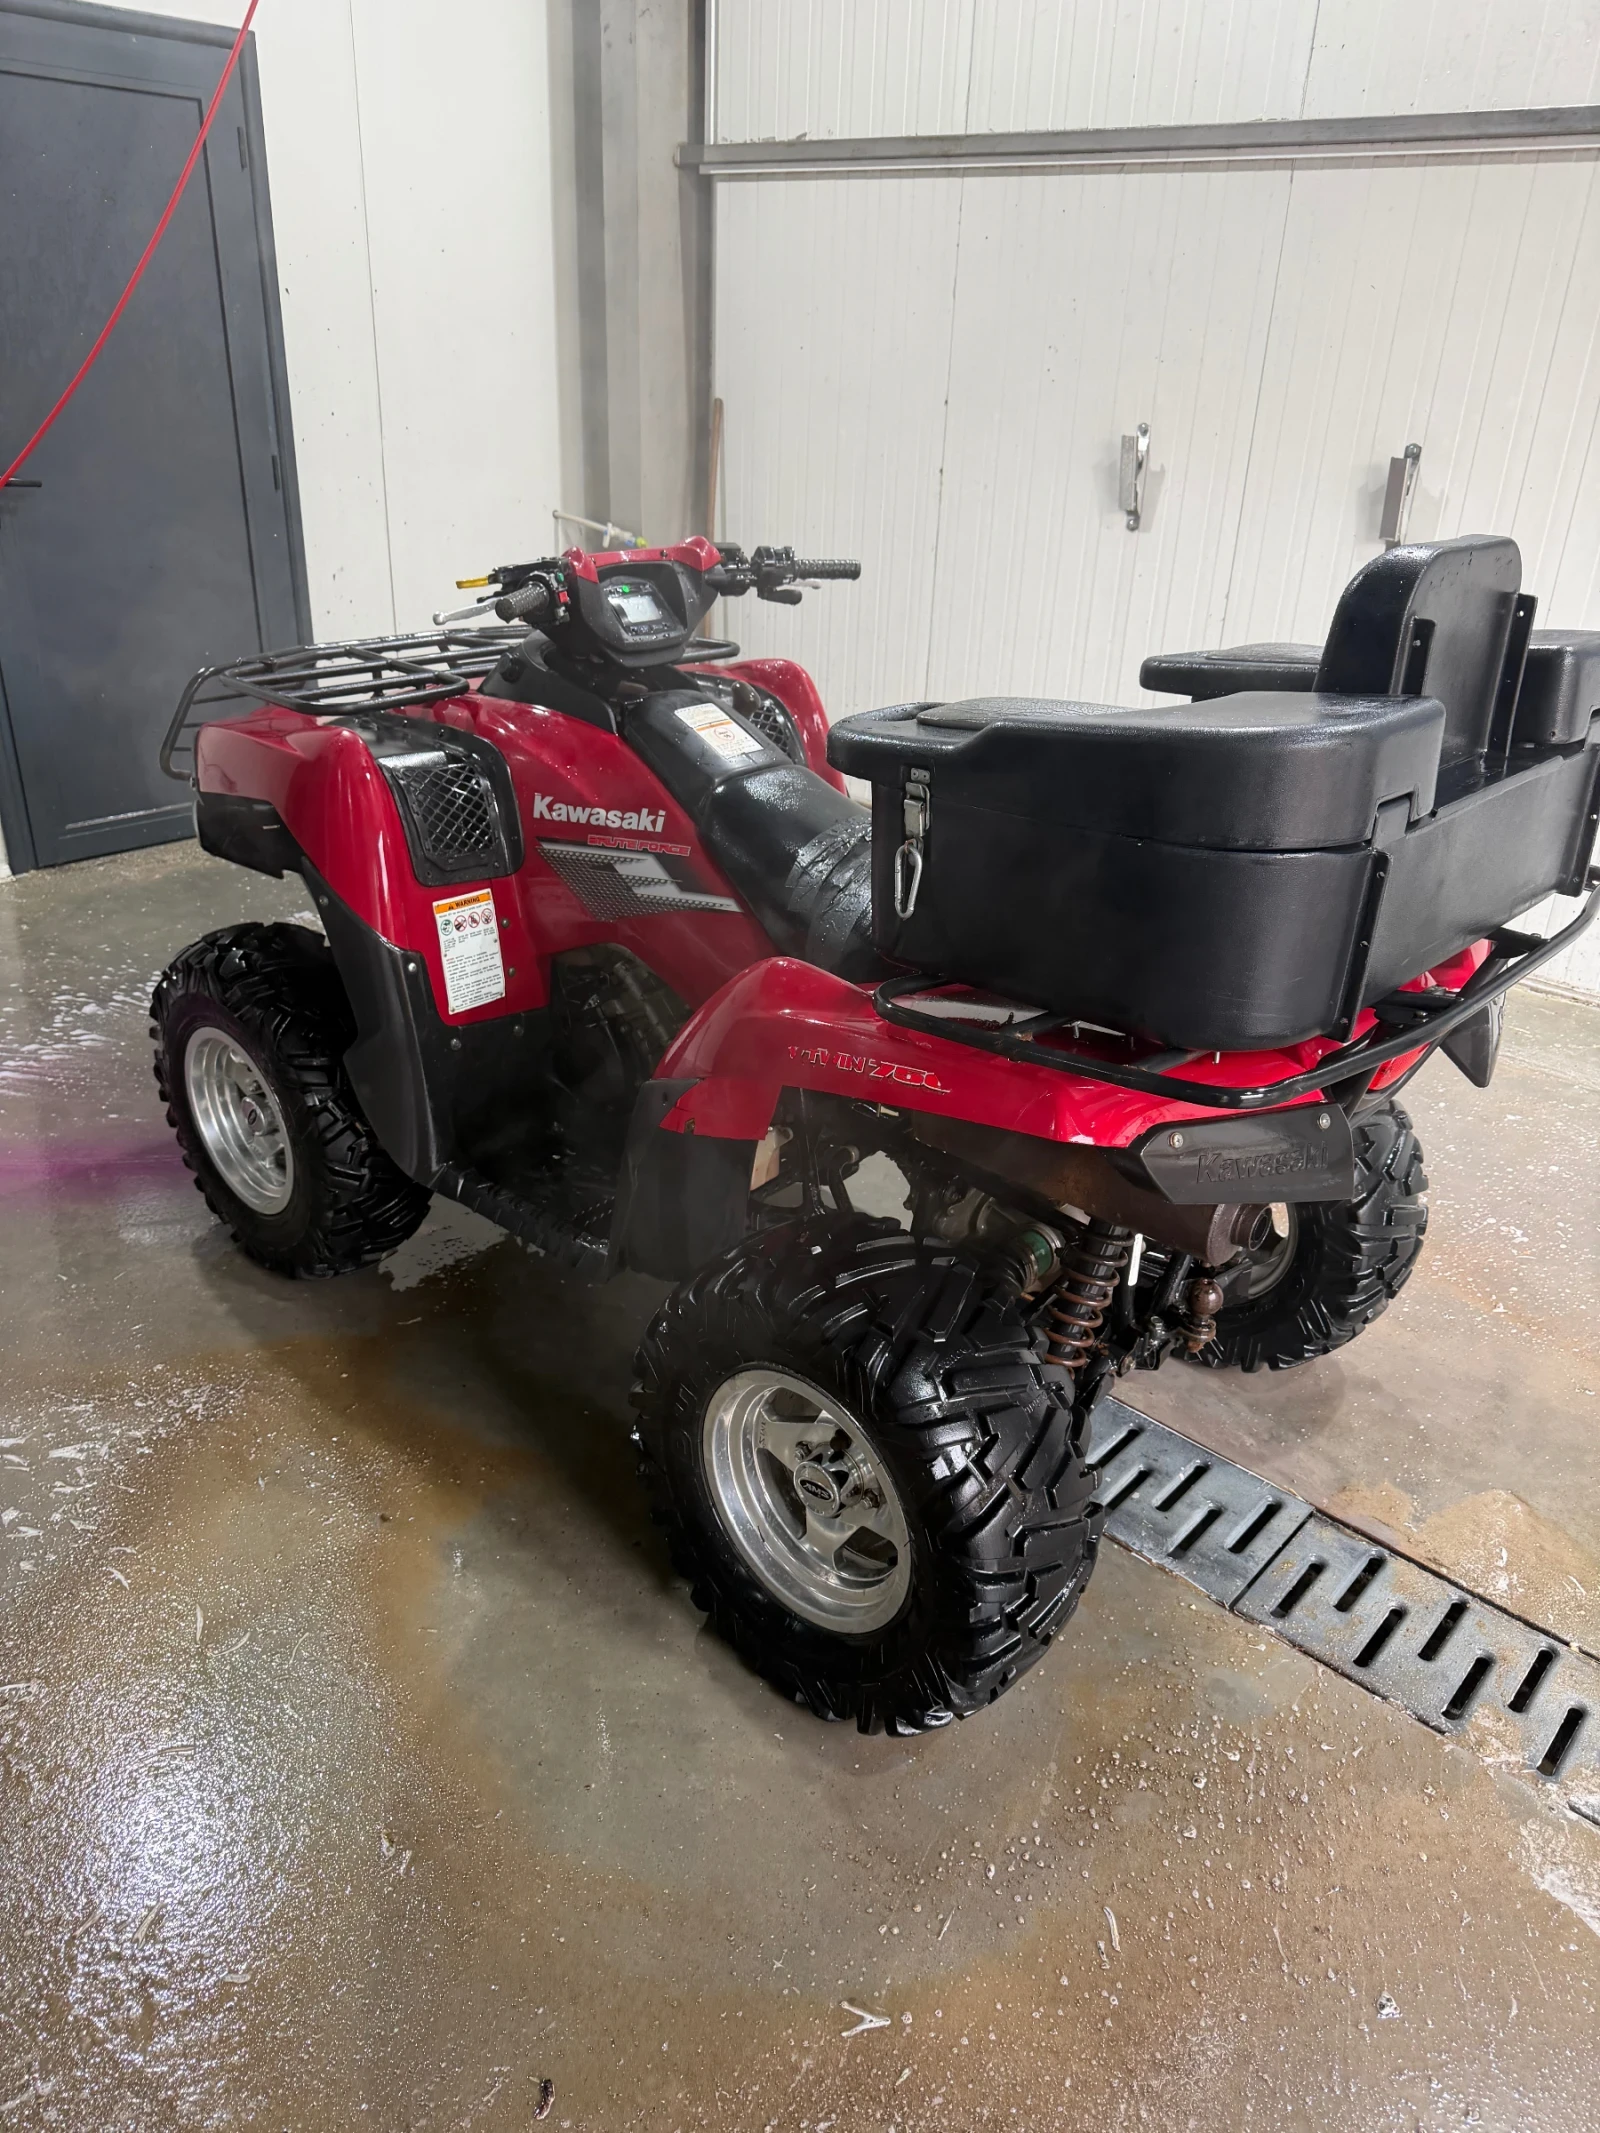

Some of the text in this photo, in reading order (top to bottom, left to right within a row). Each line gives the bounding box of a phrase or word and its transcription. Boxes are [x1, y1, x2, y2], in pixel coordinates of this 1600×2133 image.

[533, 793, 666, 833] Kawasaki
[587, 834, 691, 857] BRUTE FORCE
[454, 896, 480, 908] WARNING
[1196, 1141, 1329, 1184] Kawasaki
